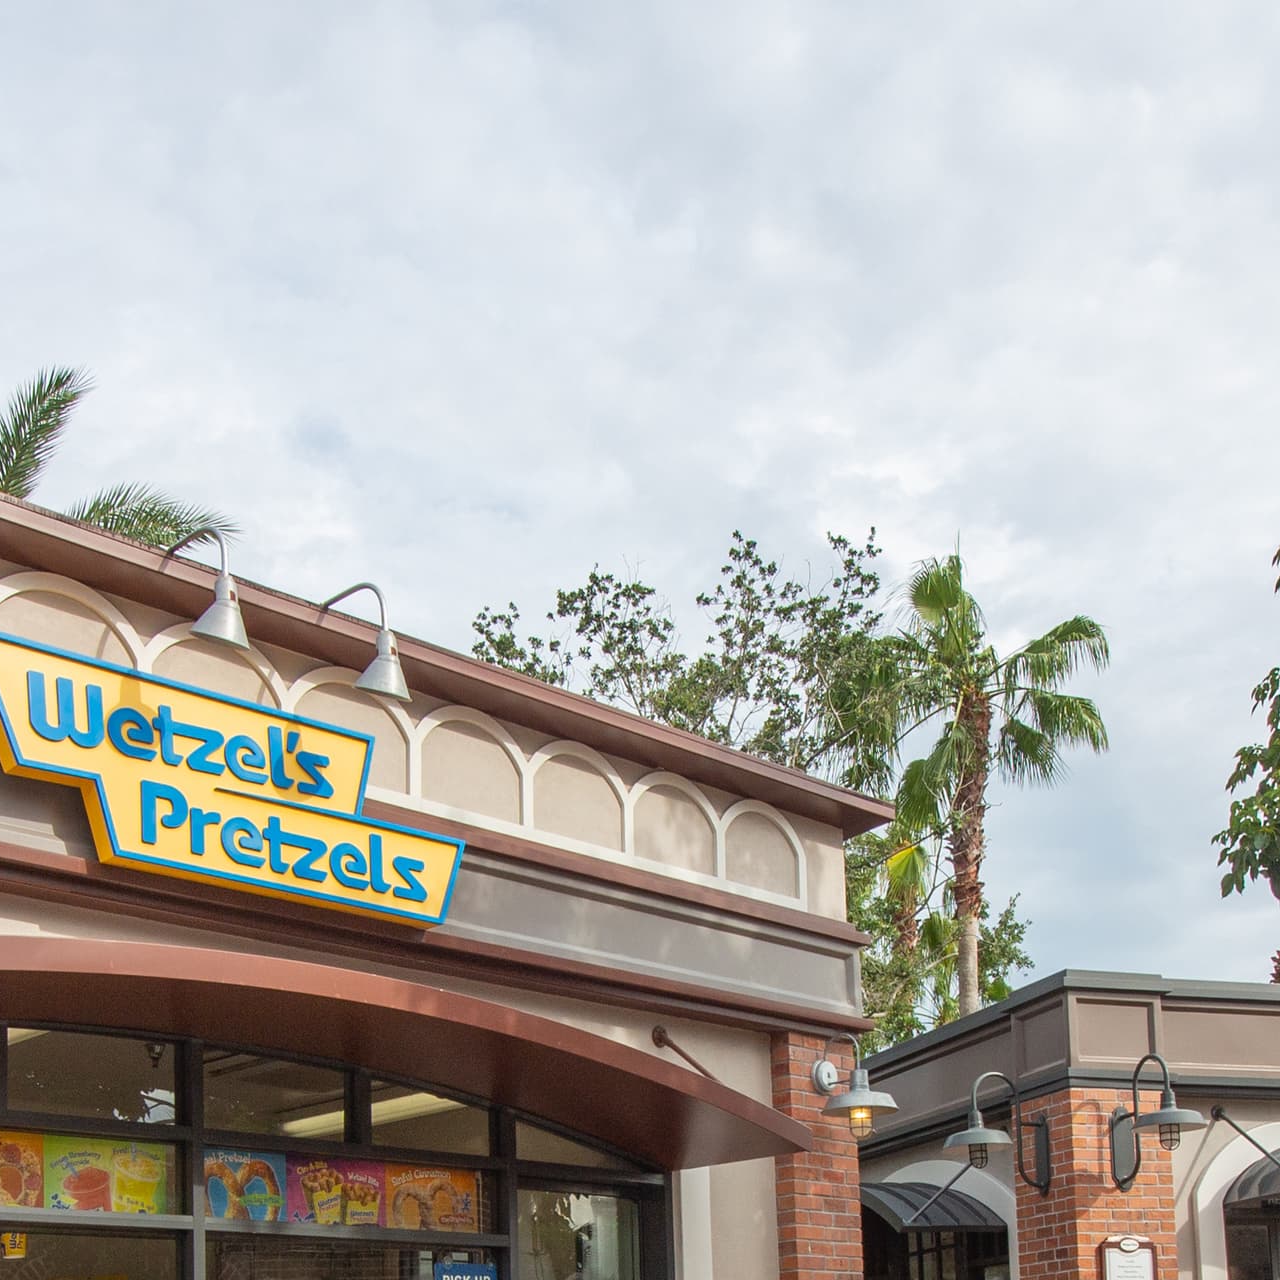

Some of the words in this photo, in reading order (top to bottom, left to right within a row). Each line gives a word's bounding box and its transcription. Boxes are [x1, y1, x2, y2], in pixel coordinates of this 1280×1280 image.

[27, 669, 335, 799] Wetzel's
[139, 779, 428, 902] Pretzels
[413, 1169, 451, 1180] Cinnamon
